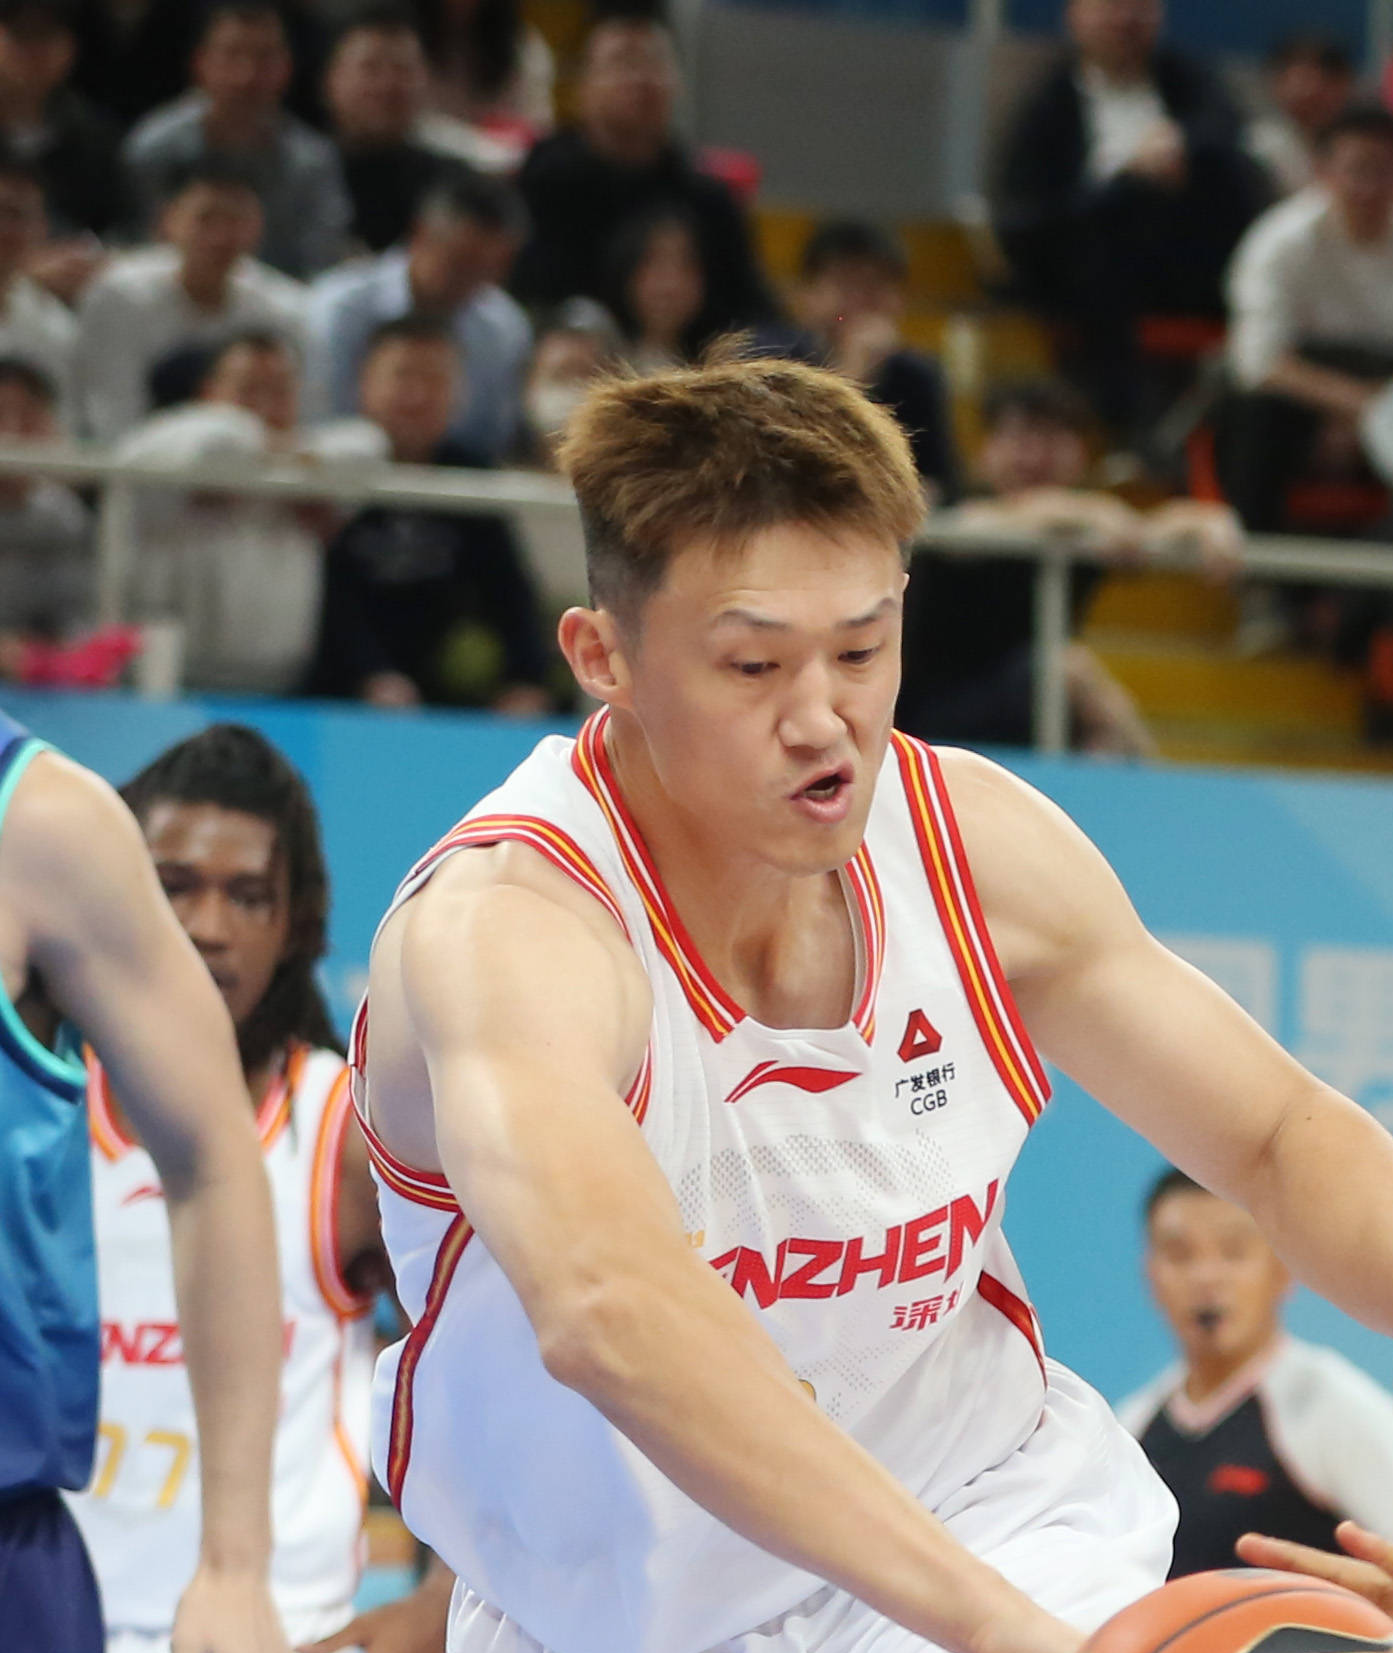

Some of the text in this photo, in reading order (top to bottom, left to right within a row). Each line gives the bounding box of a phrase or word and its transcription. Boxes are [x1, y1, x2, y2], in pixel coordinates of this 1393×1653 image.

[894, 1062, 956, 1098] 广发银行
[910, 1089, 948, 1115] CGB
[707, 1178, 999, 1310] NZHEN
